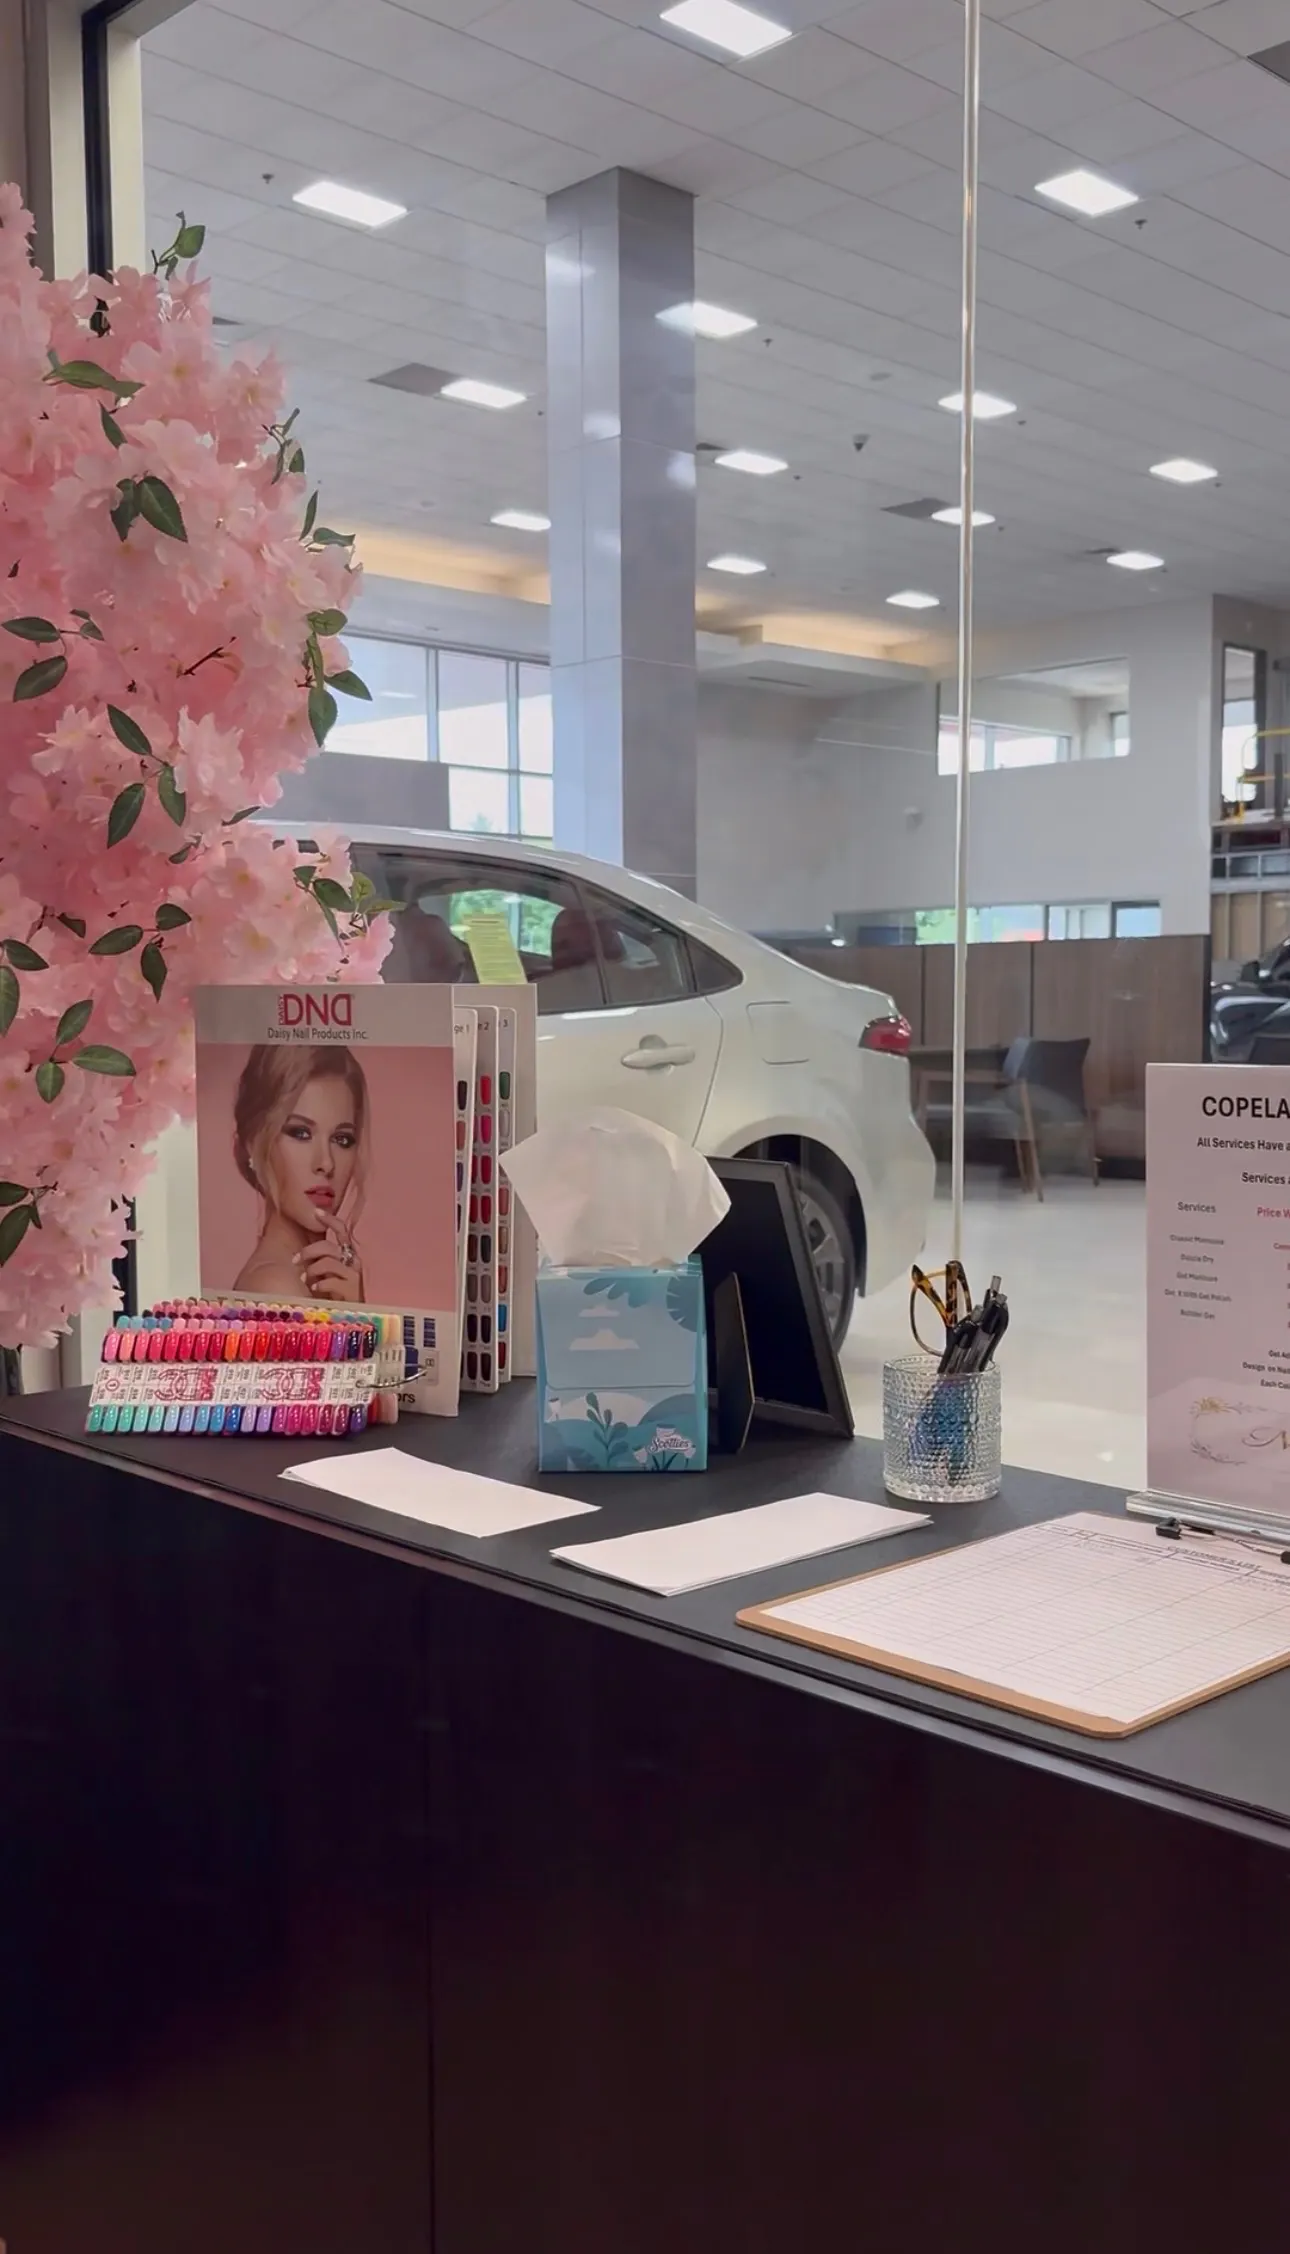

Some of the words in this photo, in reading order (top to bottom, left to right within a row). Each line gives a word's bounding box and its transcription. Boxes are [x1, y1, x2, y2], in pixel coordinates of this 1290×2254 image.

[283, 993, 352, 1026] DND
[484, 1022, 489, 1030] 2
[267, 1027, 291, 1041] Daisy
[293, 1027, 309, 1039] Nail
[312, 1027, 350, 1040] Products
[1202, 1096, 1290, 1119] COPELA
[1197, 1137, 1211, 1148] All
[1212, 1137, 1255, 1149] Services
[1257, 1139, 1284, 1151] Have
[1242, 1171, 1286, 1185] Services
[1178, 1201, 1217, 1214] Services
[1257, 1206, 1281, 1218] Price
